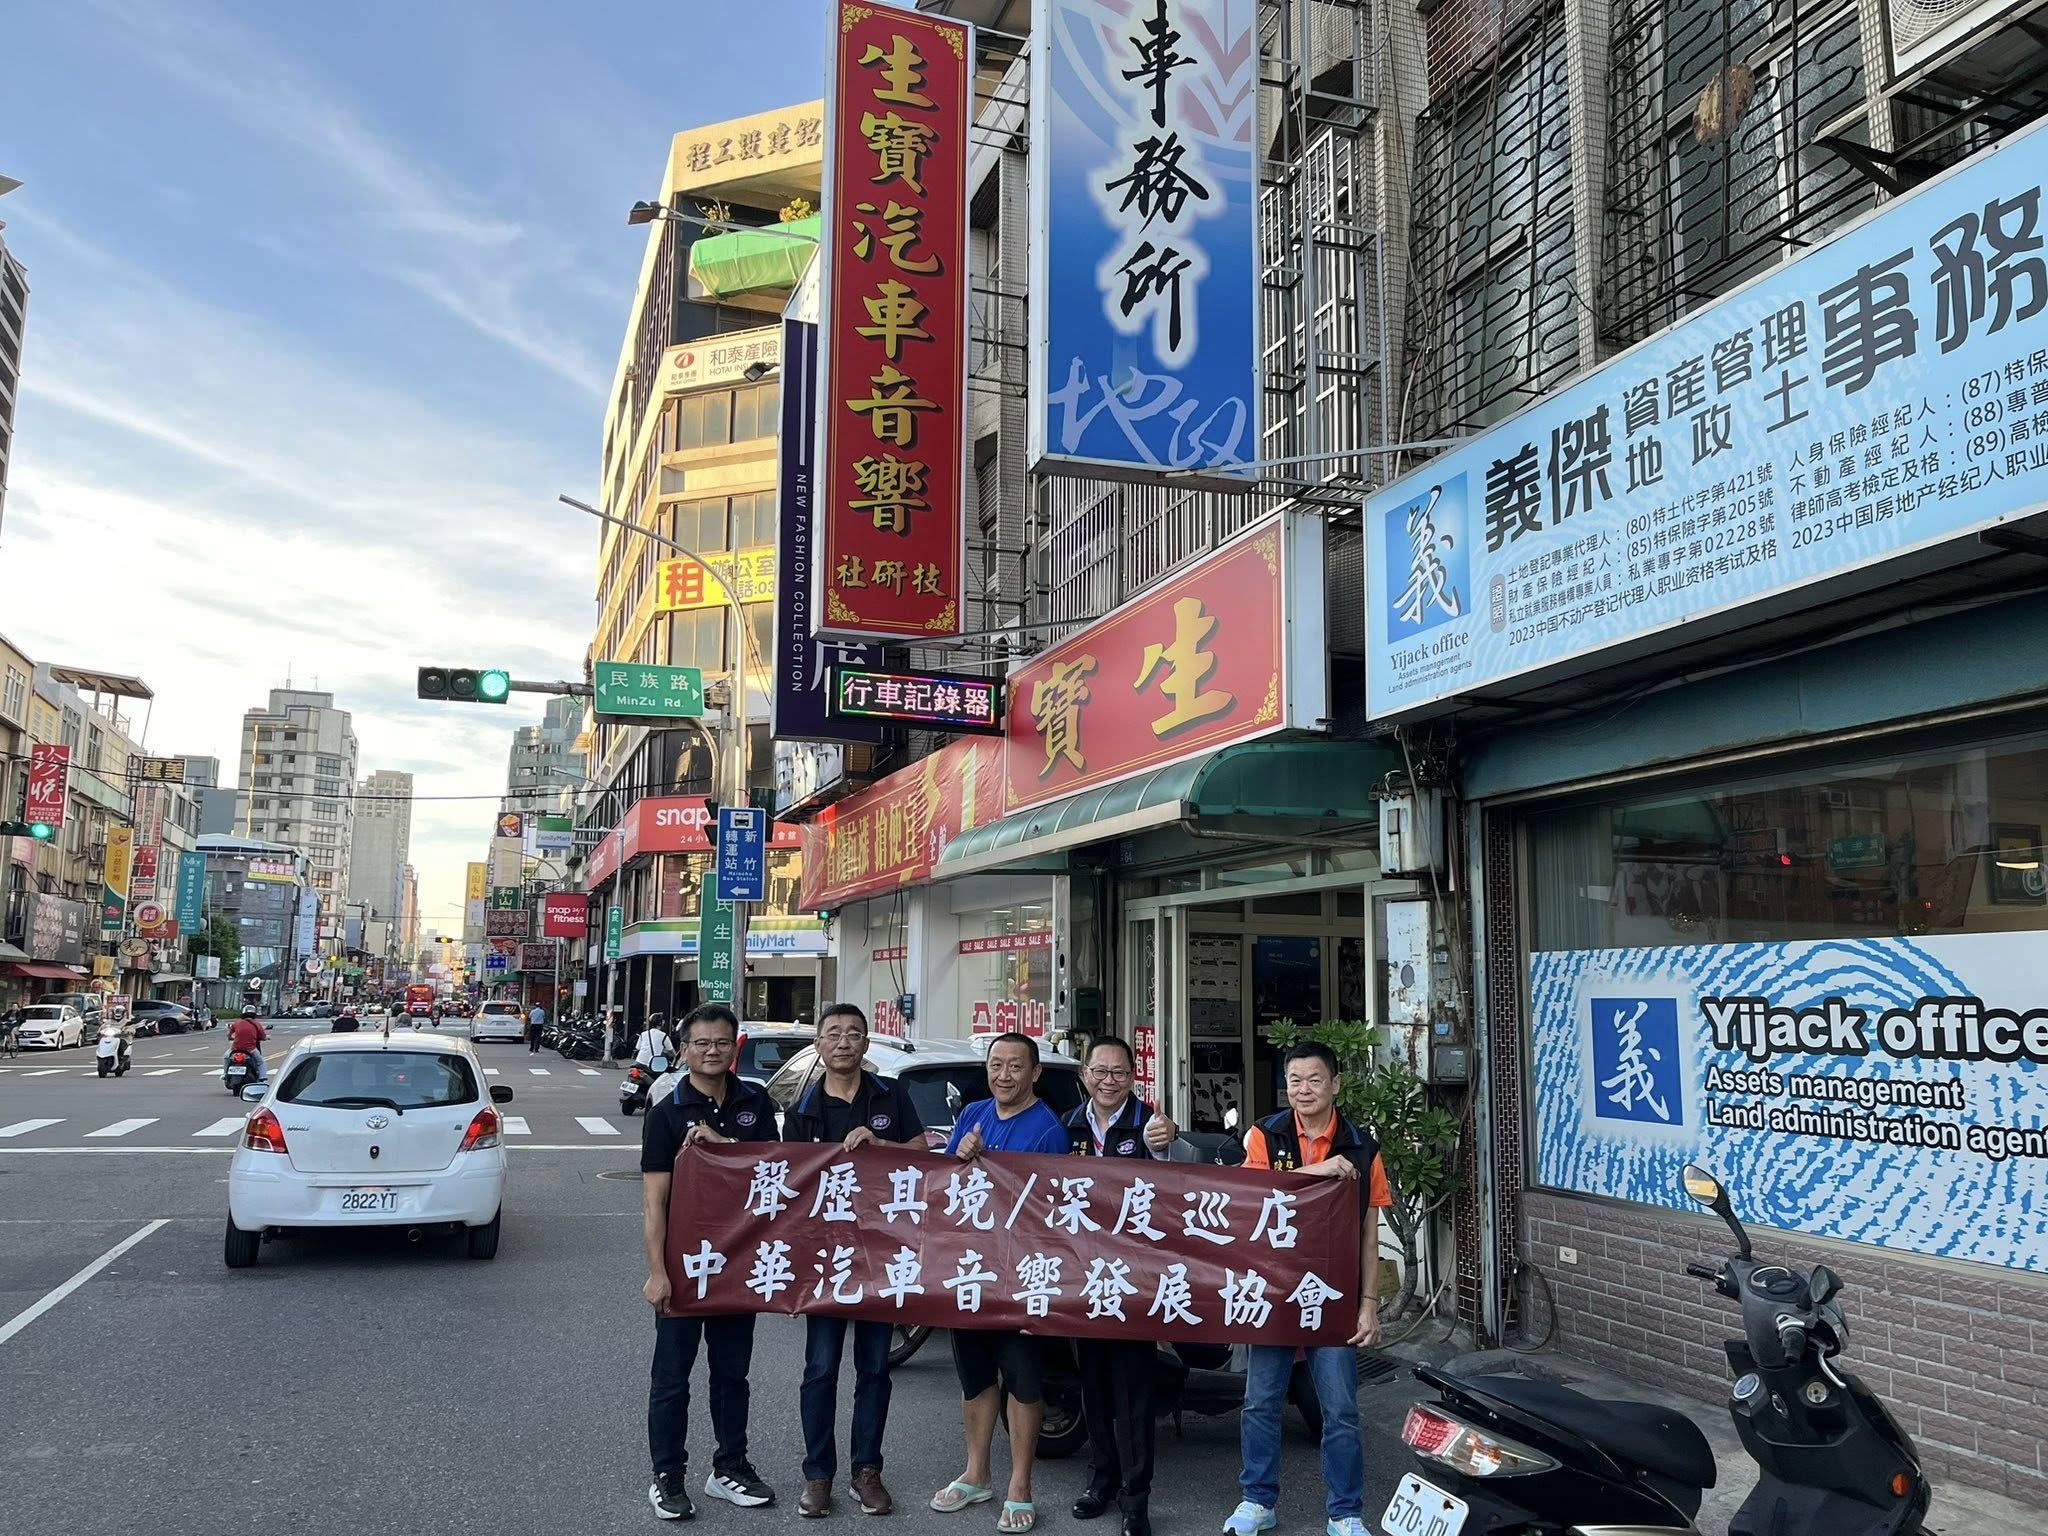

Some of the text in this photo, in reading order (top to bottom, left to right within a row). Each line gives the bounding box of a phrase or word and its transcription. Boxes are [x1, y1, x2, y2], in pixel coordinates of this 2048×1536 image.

[845, 34, 940, 532] 生寶汽車音響
[709, 364, 733, 376] HOTAI
[710, 339, 778, 367] 和泰產險
[1485, 403, 1613, 553] 義傑
[1393, 484, 1461, 625] 義
[665, 562, 705, 608] 租
[722, 580, 775, 600] 話:03
[792, 474, 807, 692] NEW FASHION COLLECTION
[1390, 630, 1470, 671] Yijack office
[1397, 652, 1462, 681] Assets management
[609, 670, 690, 692] 民族路
[843, 676, 991, 718] 行車記錄器
[1388, 659, 1473, 695] Land administration agents
[616, 695, 656, 708] MinZu
[656, 807, 711, 831] snap
[725, 830, 738, 870] 轉運站
[743, 830, 757, 870] 新竹
[547, 906, 571, 915] snap
[552, 914, 585, 923] fitness
[610, 914, 619, 948] 民生路
[712, 899, 732, 970] 民生路
[974, 941, 984, 950] SALE
[987, 940, 998, 949] SALE
[1000, 938, 1011, 948] SALE
[1014, 936, 1026, 947] SALE
[1028, 935, 1041, 945] SALE
[1703, 1001, 2048, 1058] Yijack office
[1601, 1001, 1669, 1121] 義
[1706, 1066, 1964, 1108] Assets management
[1707, 1100, 1763, 1128] Land
[1770, 1106, 1960, 1148] administration
[744, 1159, 1299, 1249] 聲歷其境/深度巡店
[682, 1239, 1344, 1331] 中華汽車音響發展協會
